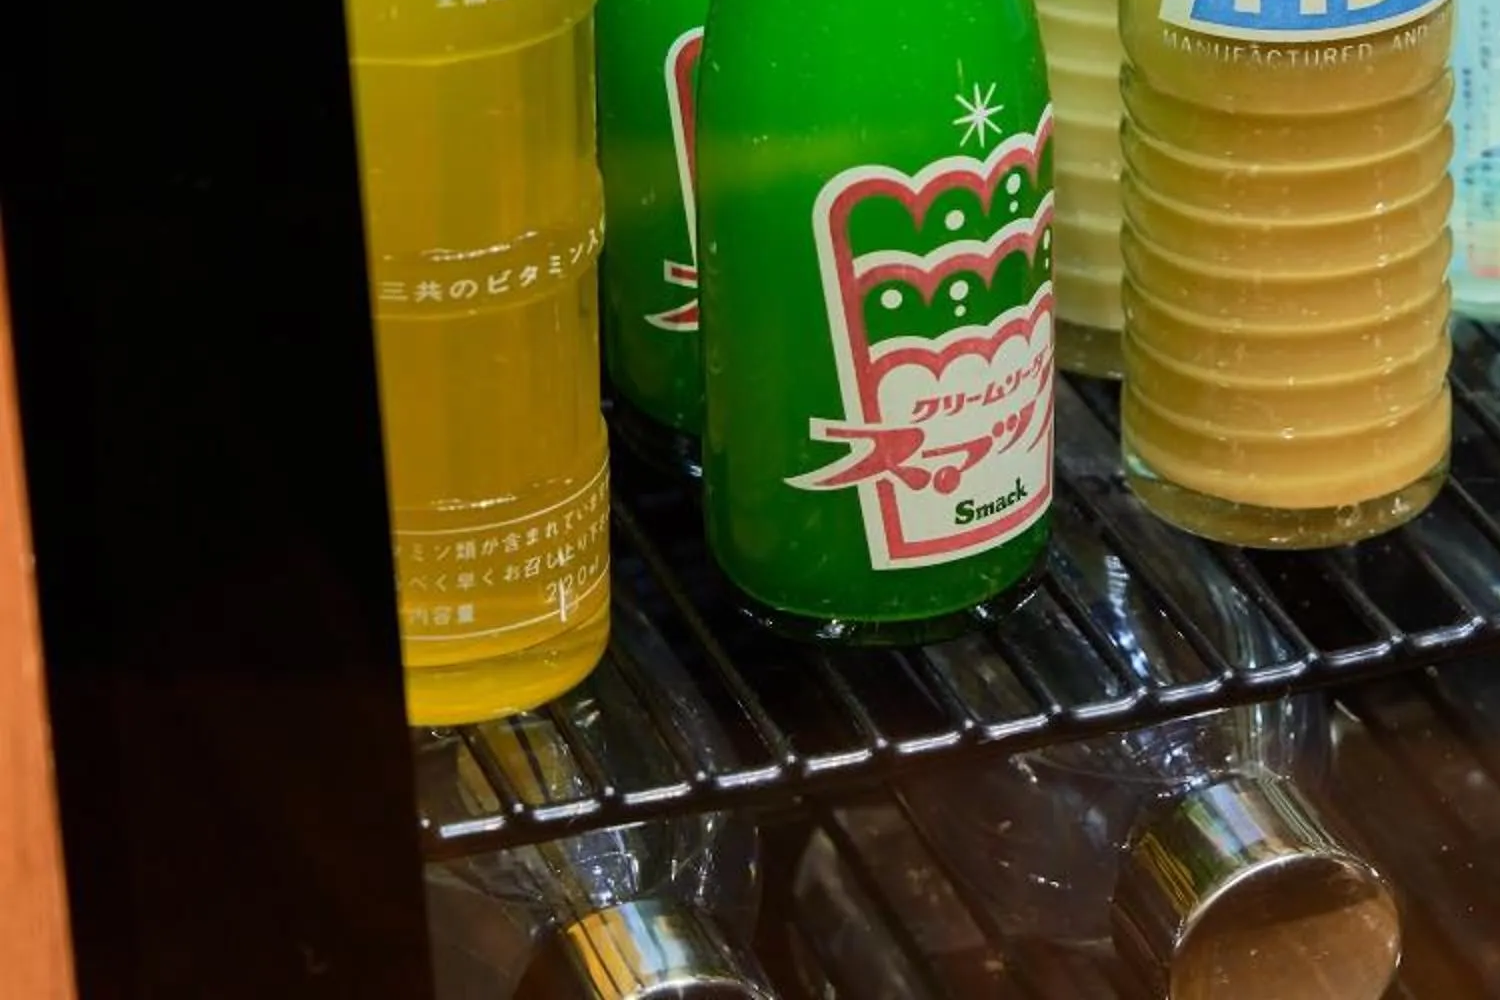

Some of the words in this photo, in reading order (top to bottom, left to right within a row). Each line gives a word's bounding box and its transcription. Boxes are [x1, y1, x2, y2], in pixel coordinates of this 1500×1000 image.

[1161, 28, 1373, 68] MANUFACTURED
[910, 351, 1044, 424] クリームソーダ
[953, 475, 1029, 526] Smack
